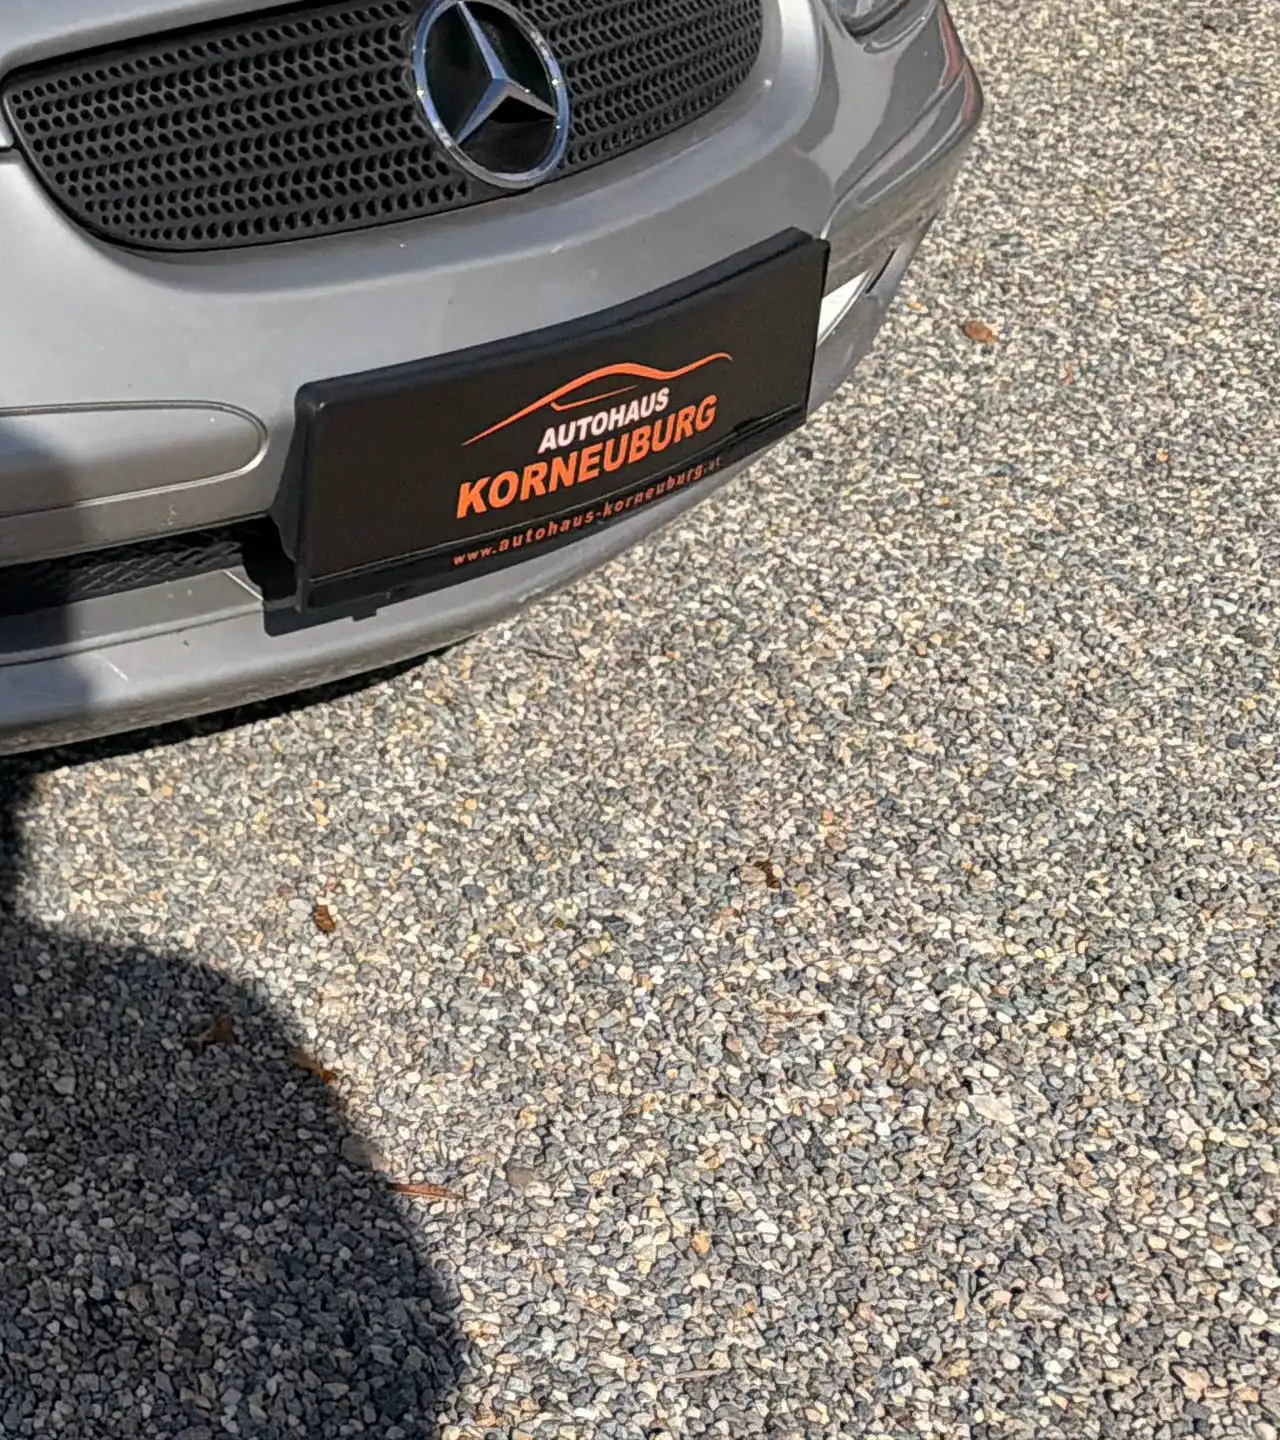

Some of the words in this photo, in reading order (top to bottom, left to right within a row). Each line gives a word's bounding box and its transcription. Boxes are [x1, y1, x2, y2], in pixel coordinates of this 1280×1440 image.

[455, 393, 719, 520] KORNEUBURG
[537, 386, 671, 455] AUTOHAUS
[451, 455, 721, 567] www.autohaus-korneuburg.at
